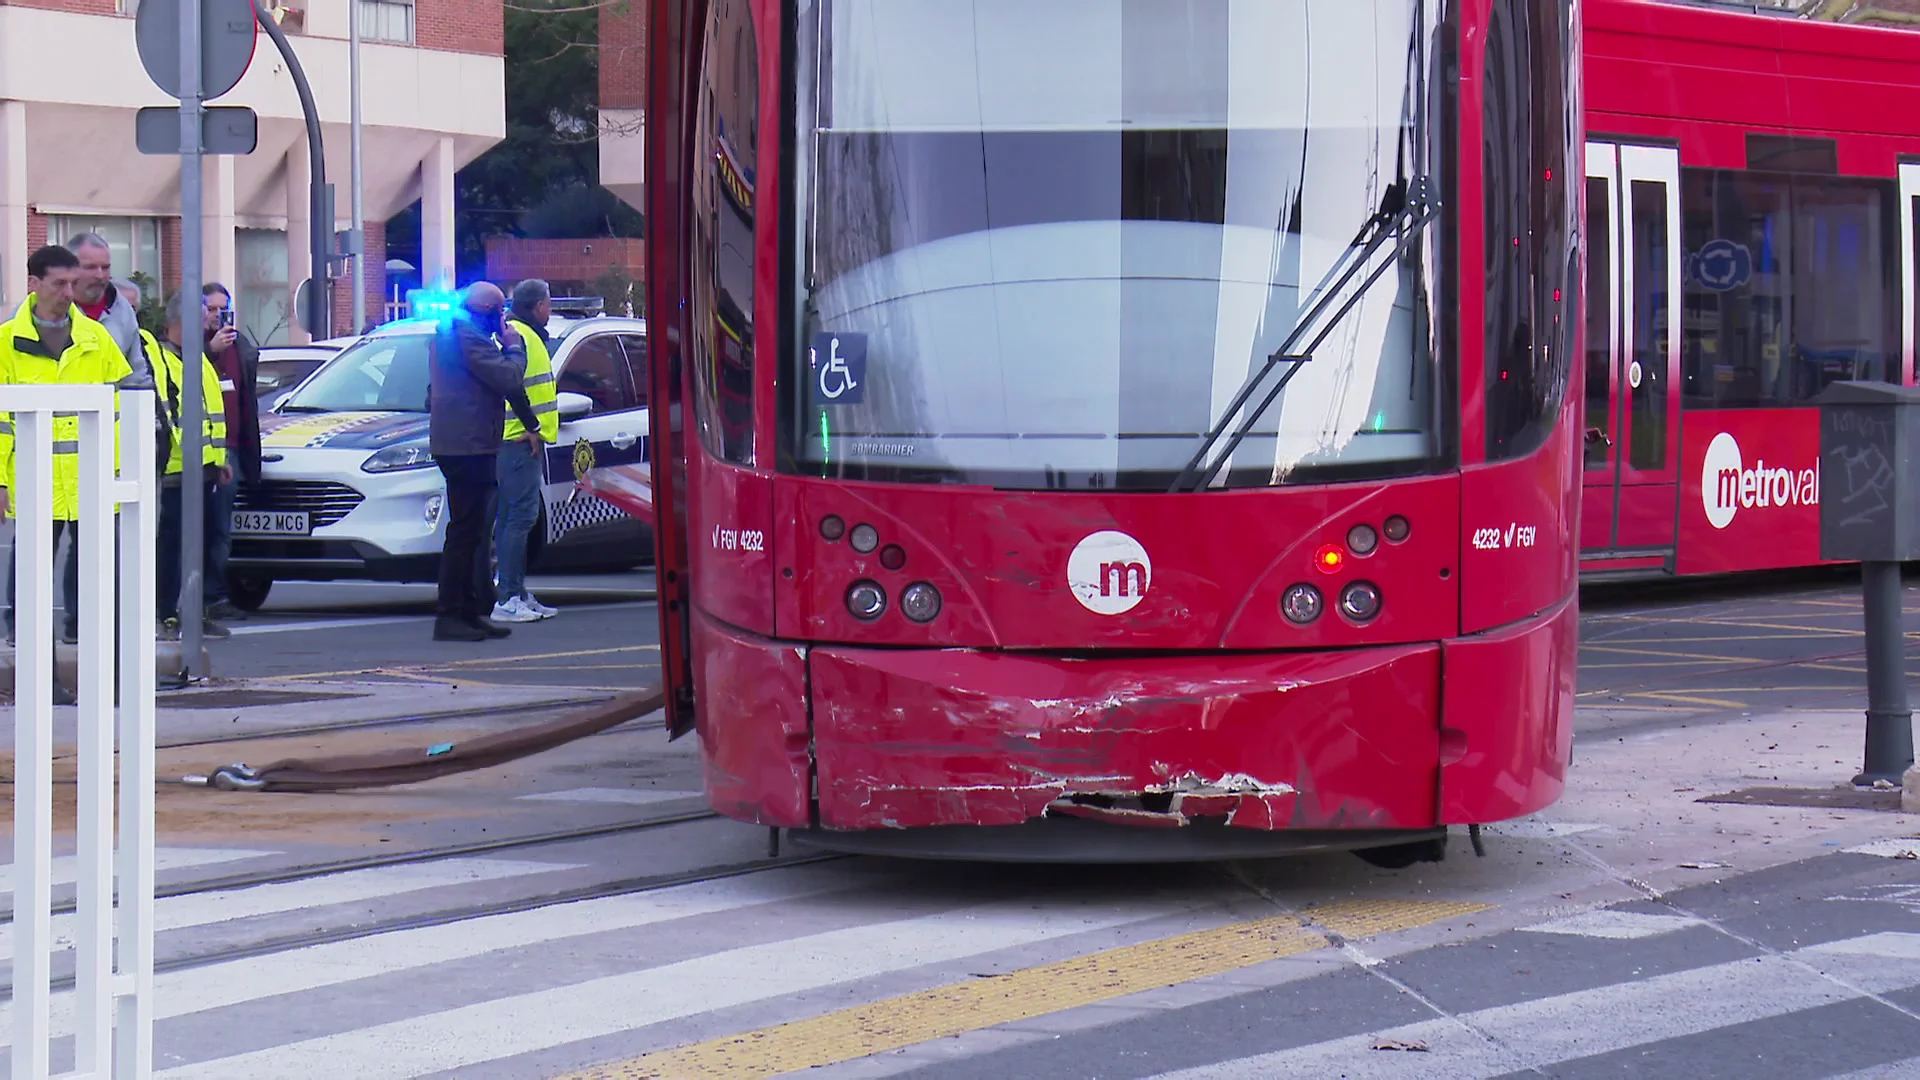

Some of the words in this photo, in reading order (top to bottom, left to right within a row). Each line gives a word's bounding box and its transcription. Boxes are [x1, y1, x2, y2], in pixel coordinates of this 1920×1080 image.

[851, 443, 914, 456] BOMBARDIER
[1717, 456, 1820, 509] metroval
[234, 514, 271, 531] 9432
[275, 514, 303, 531] MCG
[721, 529, 738, 550] FGV
[740, 529, 764, 551] 4232
[1472, 527, 1501, 550] 4232
[1517, 526, 1536, 548] FGV
[1100, 561, 1147, 597] m
